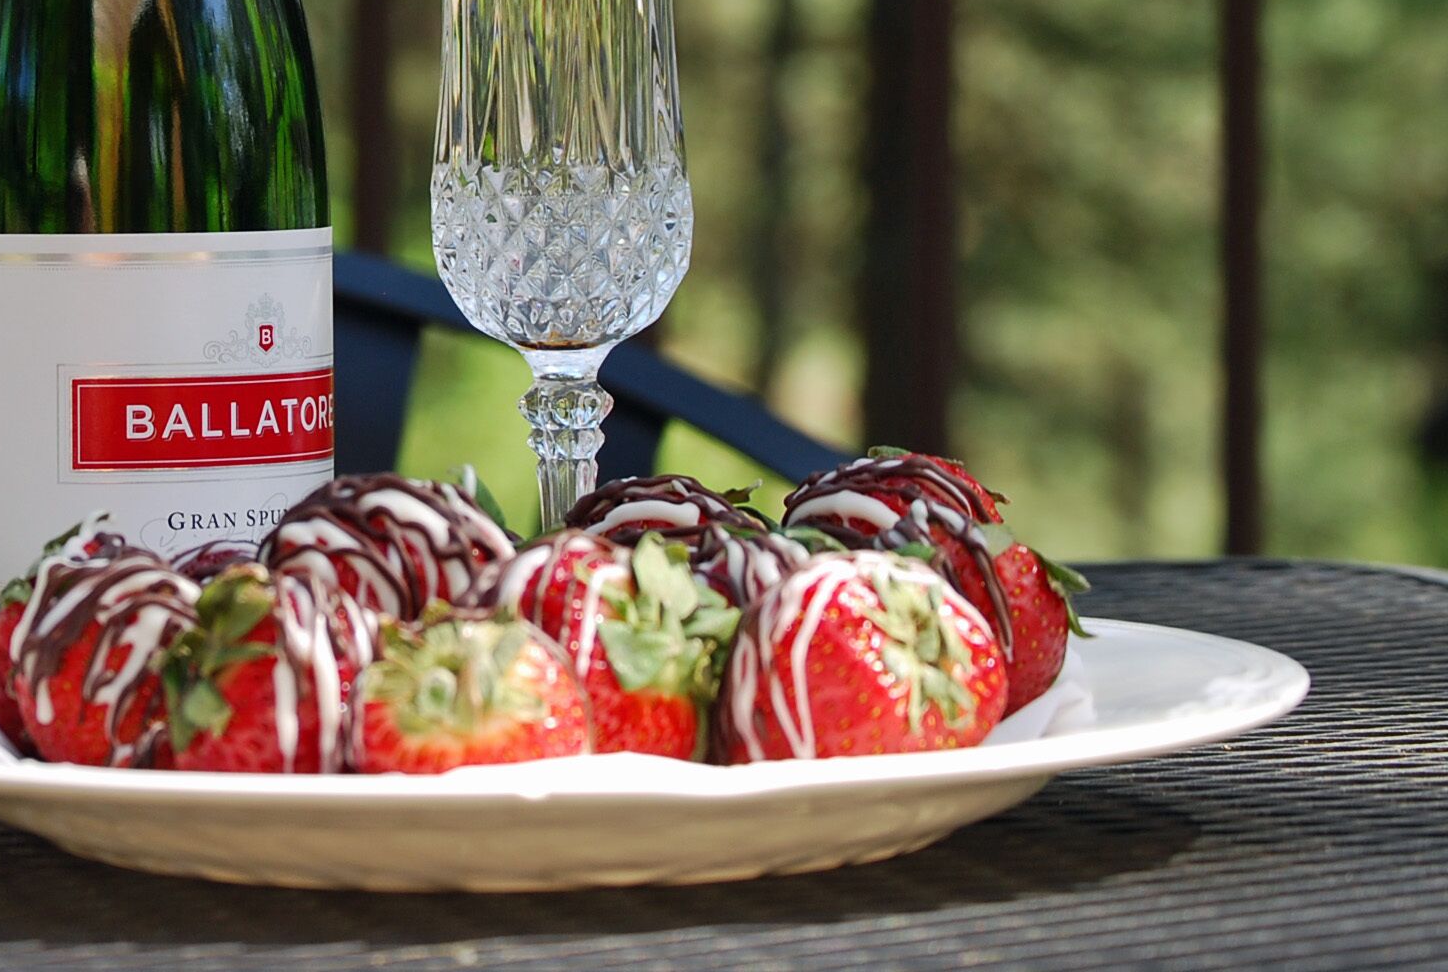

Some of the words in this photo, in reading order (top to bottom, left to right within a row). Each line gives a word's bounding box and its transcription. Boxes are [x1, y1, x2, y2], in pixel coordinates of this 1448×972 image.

[262, 329, 271, 345] B
[125, 393, 333, 440] BALLATORE
[168, 511, 237, 531] GRAN
[246, 509, 286, 527] SPU
